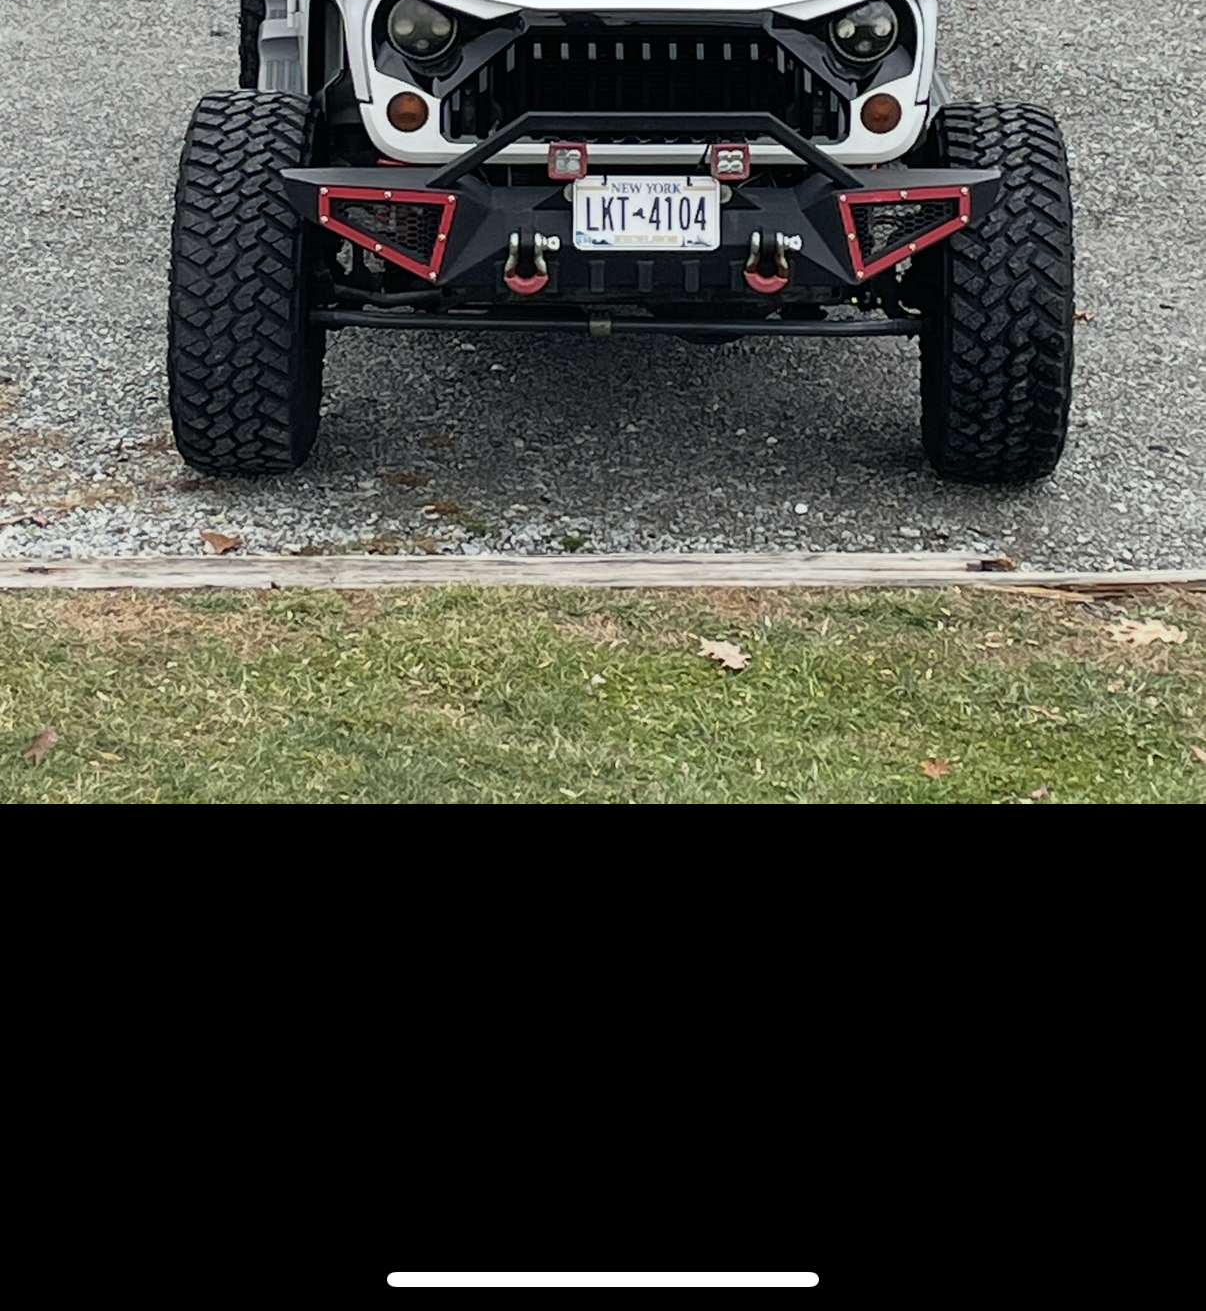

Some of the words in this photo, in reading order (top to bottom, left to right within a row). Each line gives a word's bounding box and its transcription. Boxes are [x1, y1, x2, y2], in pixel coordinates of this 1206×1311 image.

[611, 183, 643, 194] NEW
[645, 183, 682, 194] YORK
[586, 197, 629, 231] LKT
[649, 197, 706, 231] 4104
